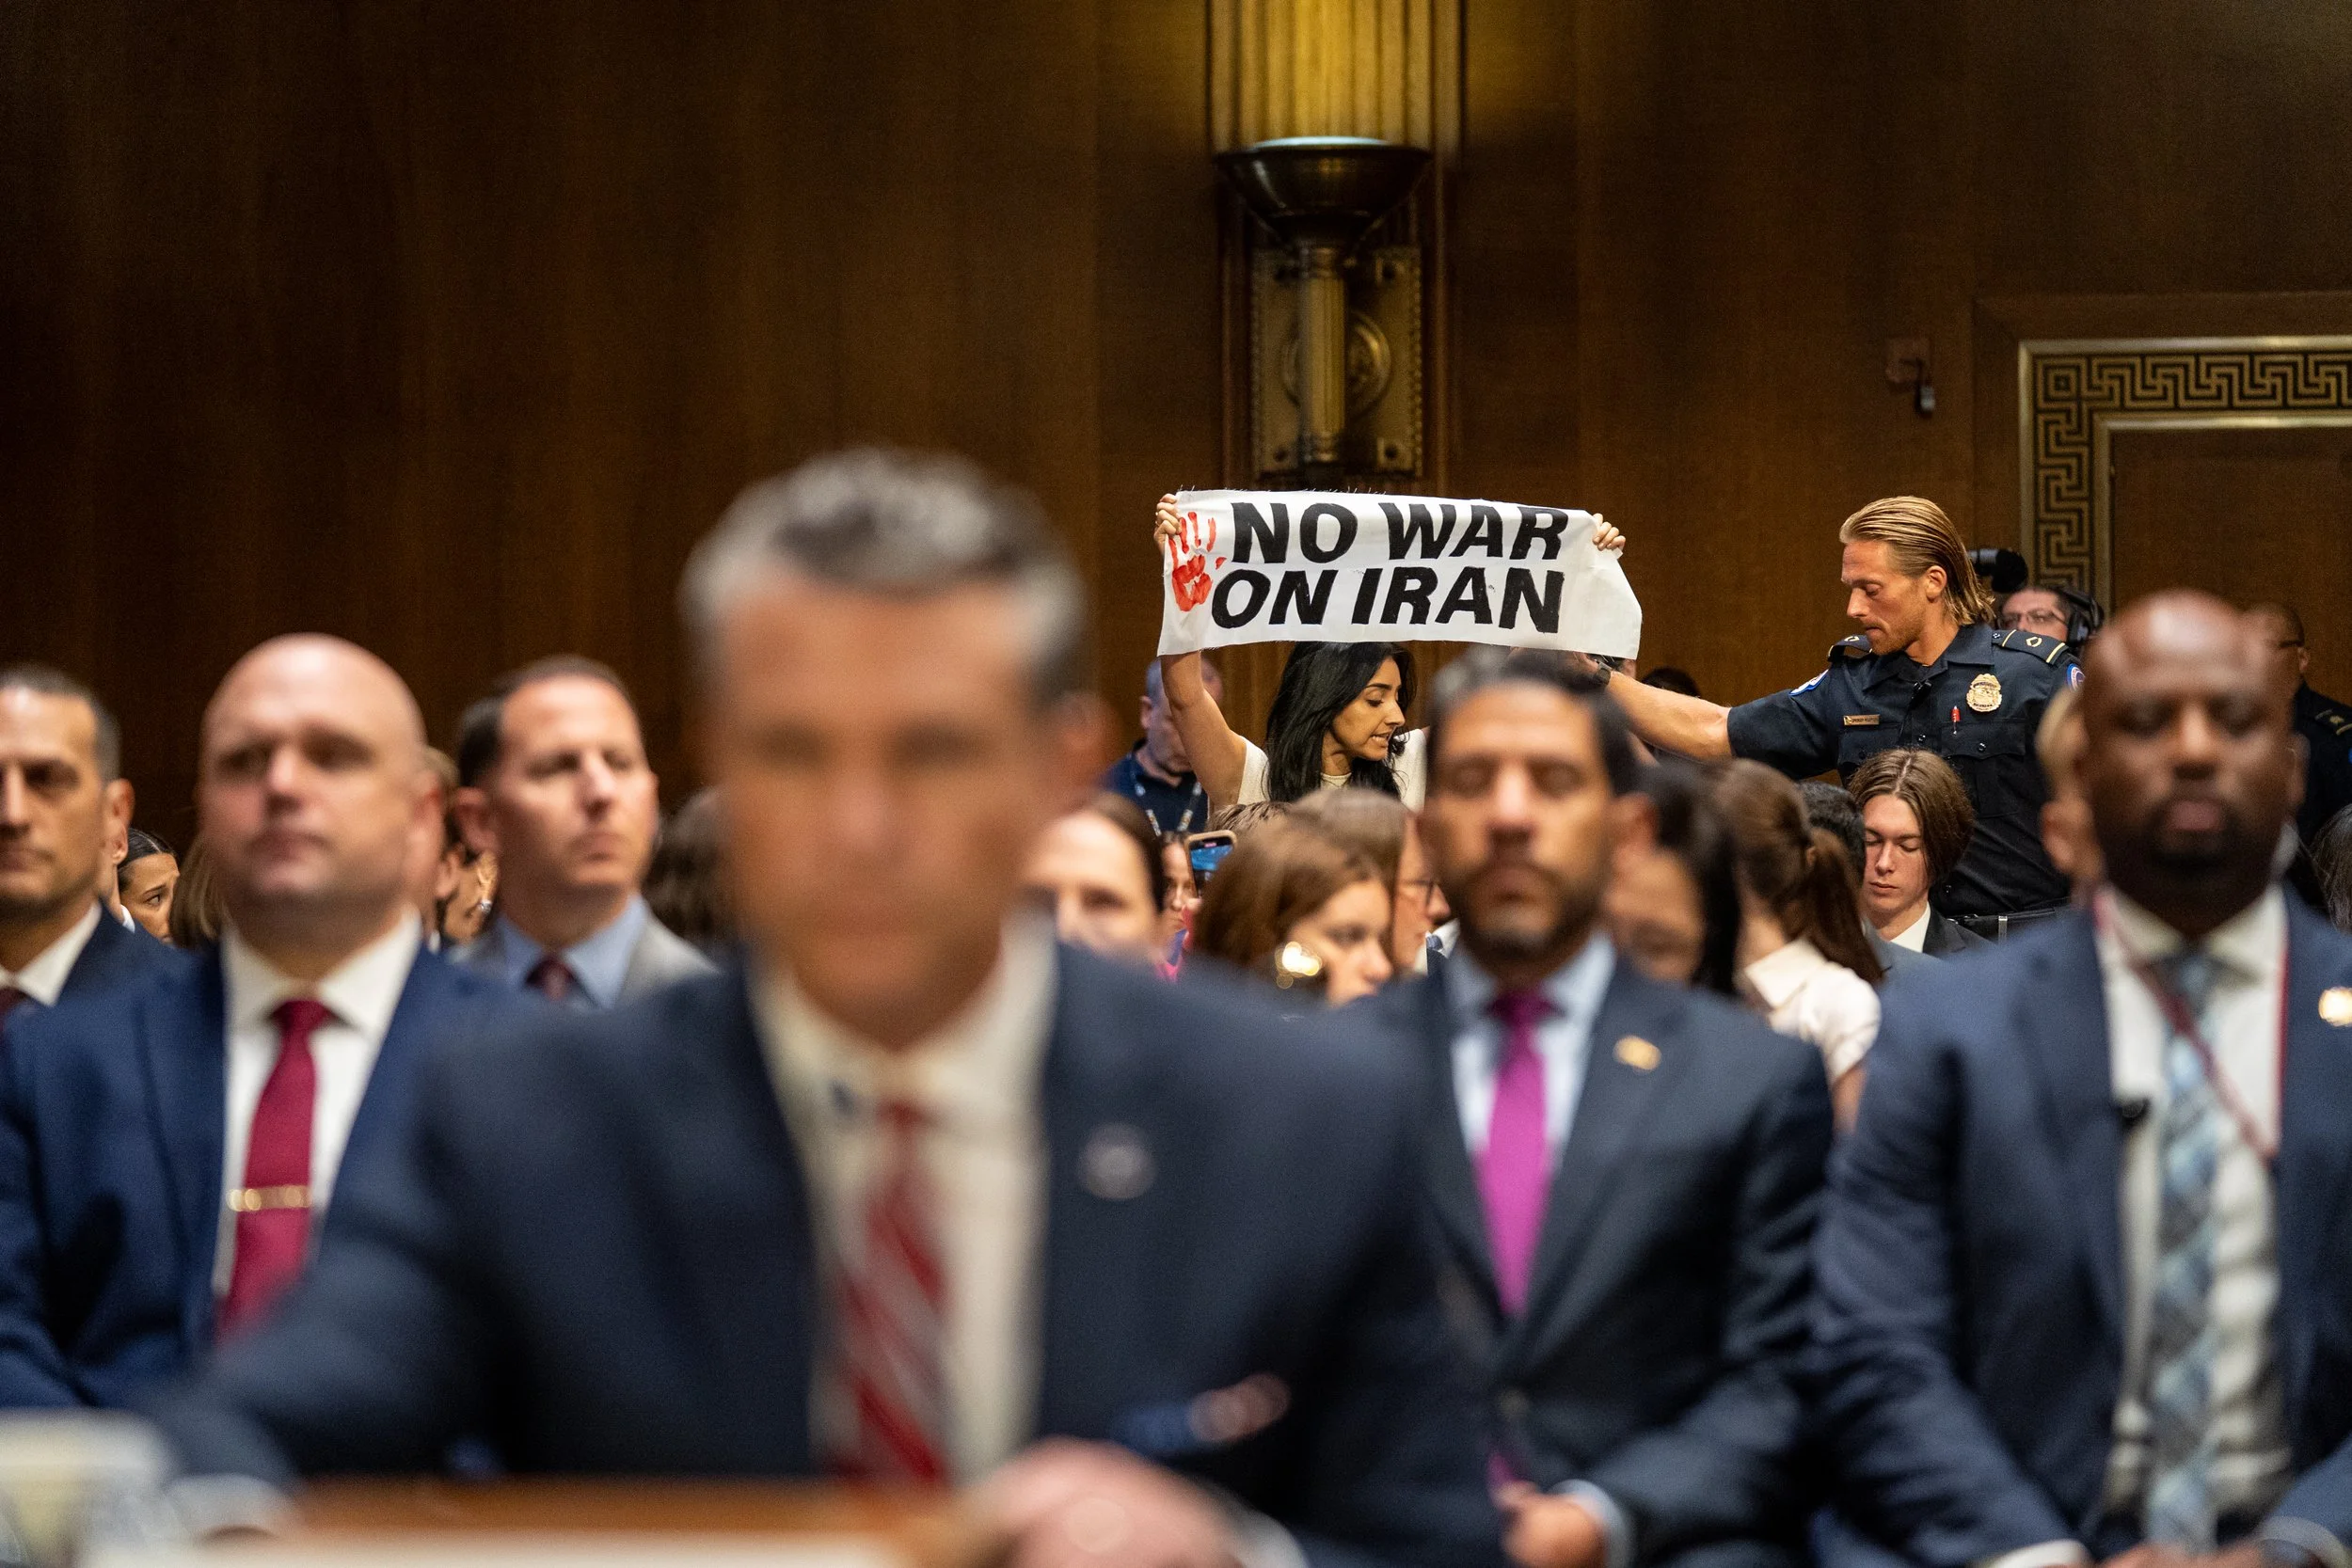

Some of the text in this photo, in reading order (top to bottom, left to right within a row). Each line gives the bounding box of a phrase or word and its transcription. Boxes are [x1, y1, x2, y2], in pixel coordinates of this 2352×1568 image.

[1231, 502, 1569, 564] NO WAR
[1211, 566, 1565, 634] ON IRAN
